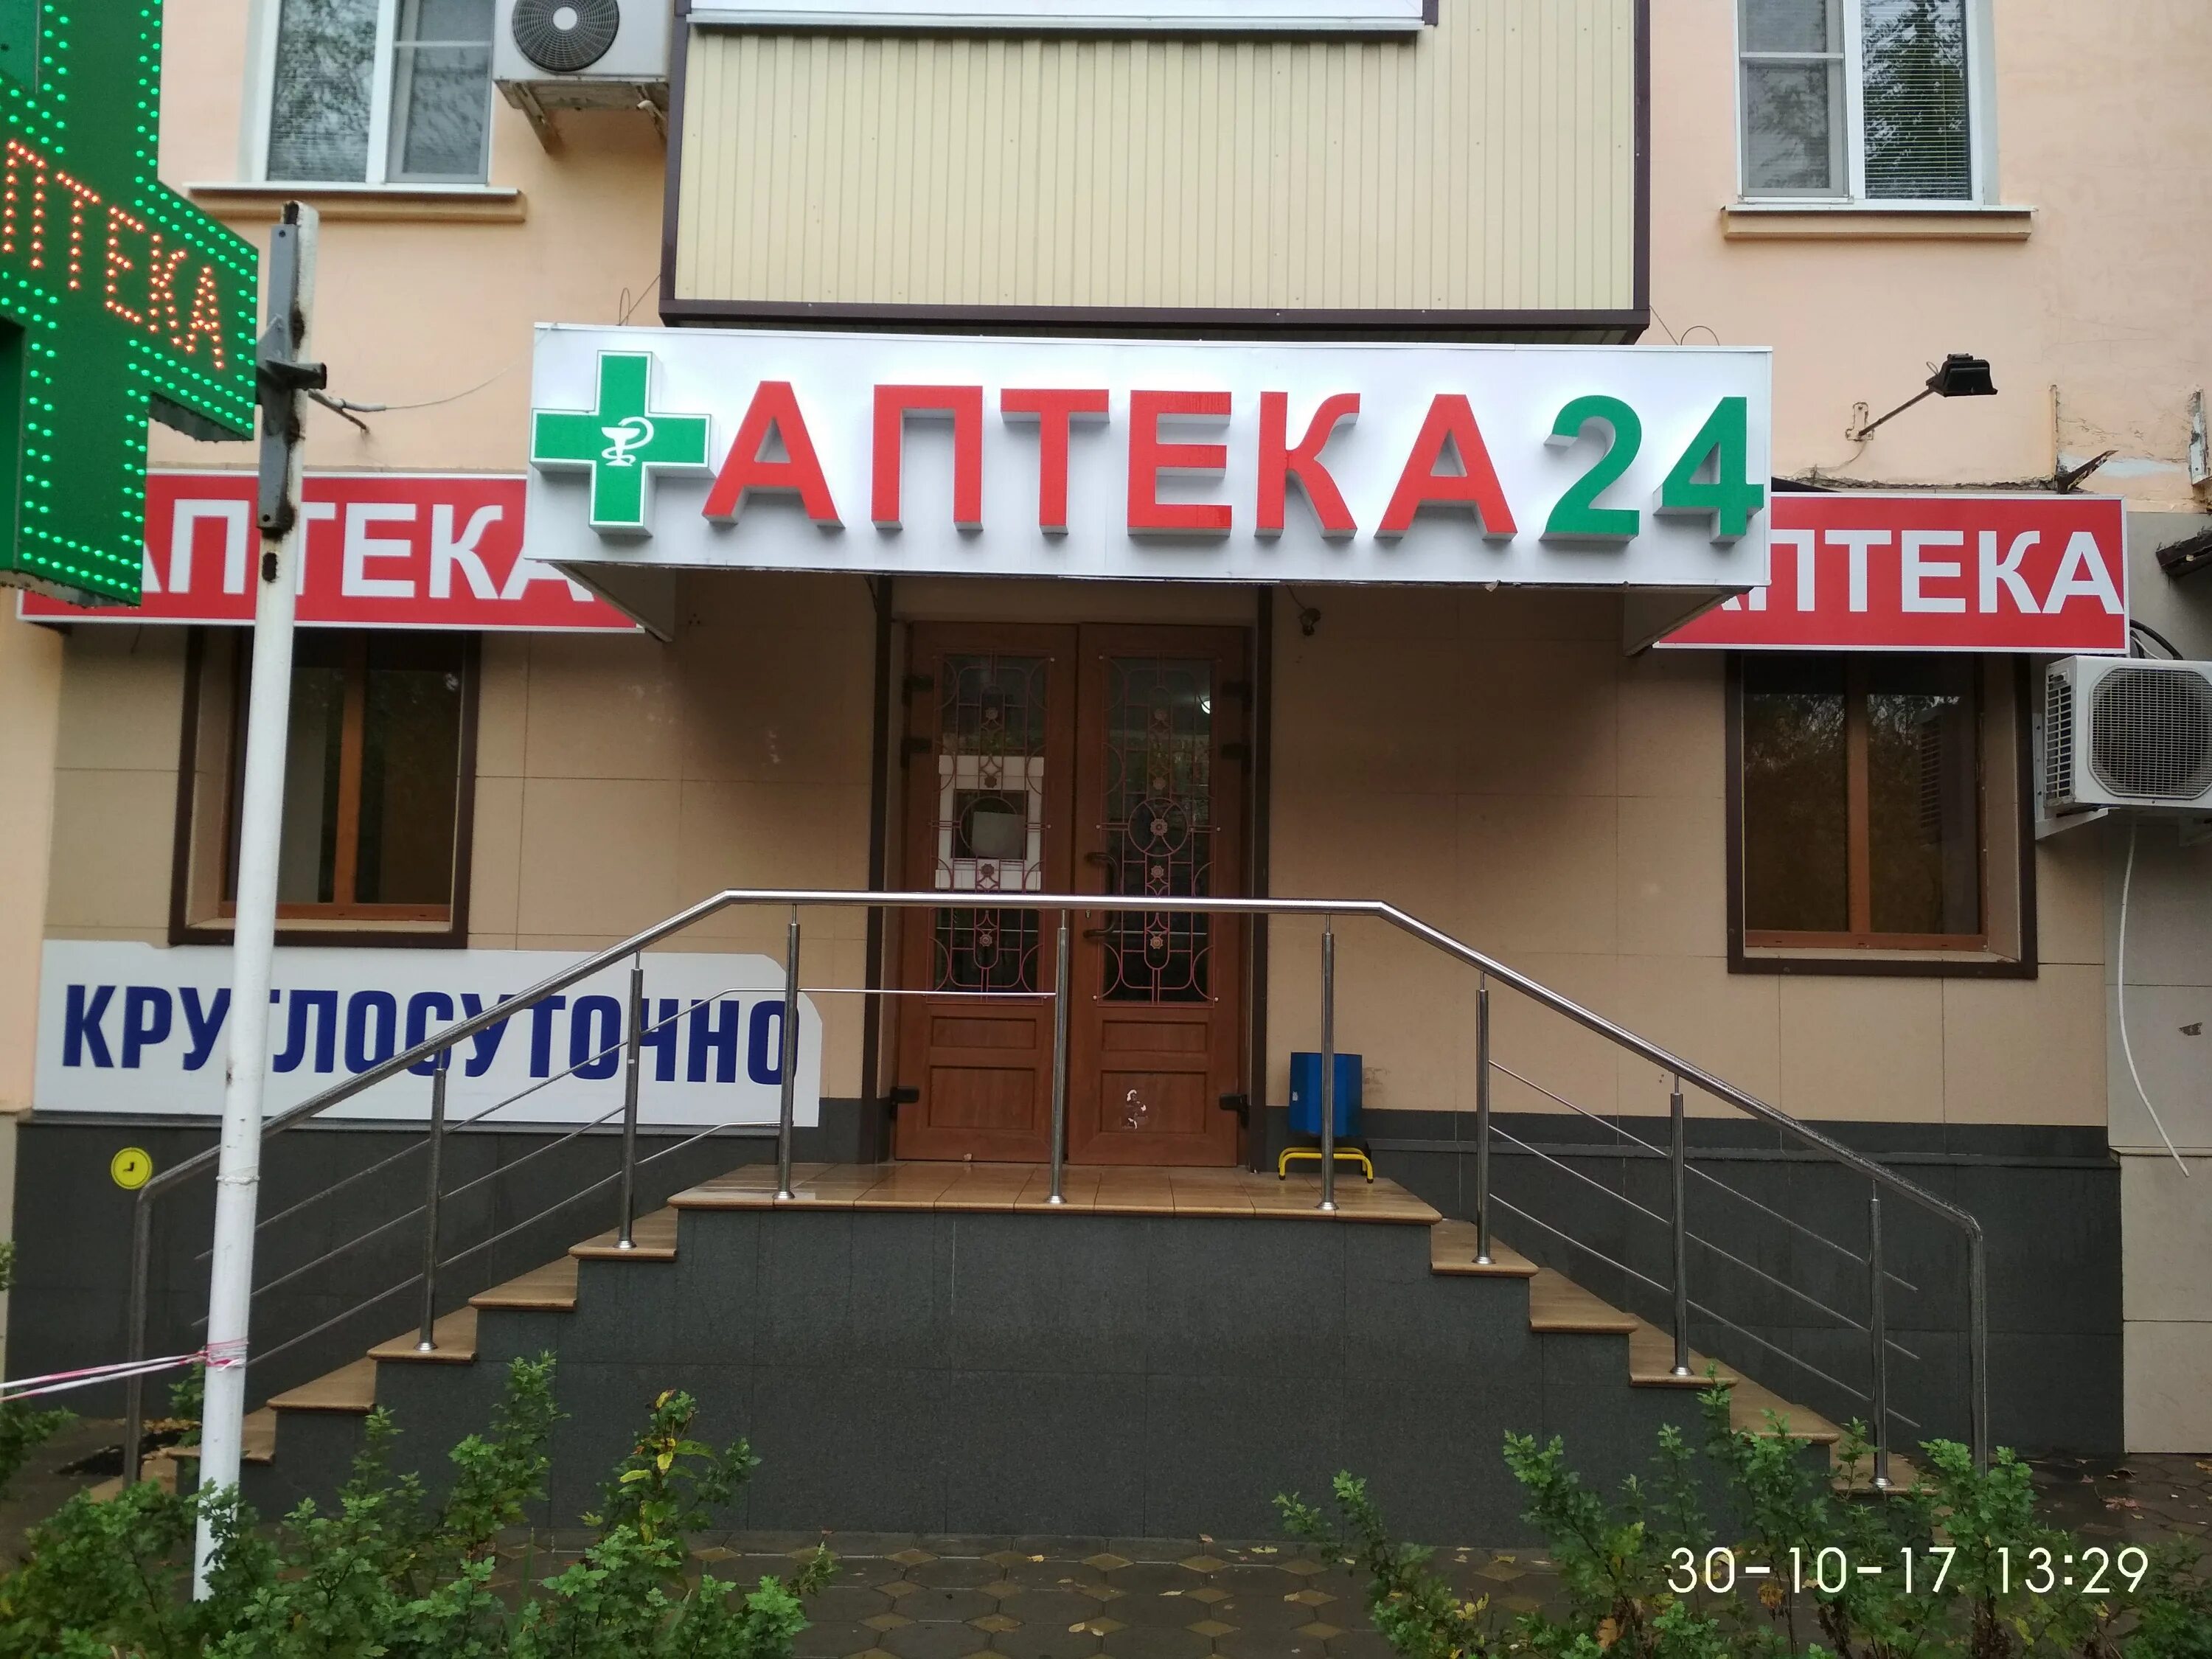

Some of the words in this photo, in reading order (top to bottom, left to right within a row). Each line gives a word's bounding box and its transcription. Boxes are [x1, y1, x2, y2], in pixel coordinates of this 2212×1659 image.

[142, 499, 595, 602] ПЕК
[1722, 529, 2124, 614] ПТЕКА
[63, 985, 799, 1085] КРУЛОСУТОЧНО
